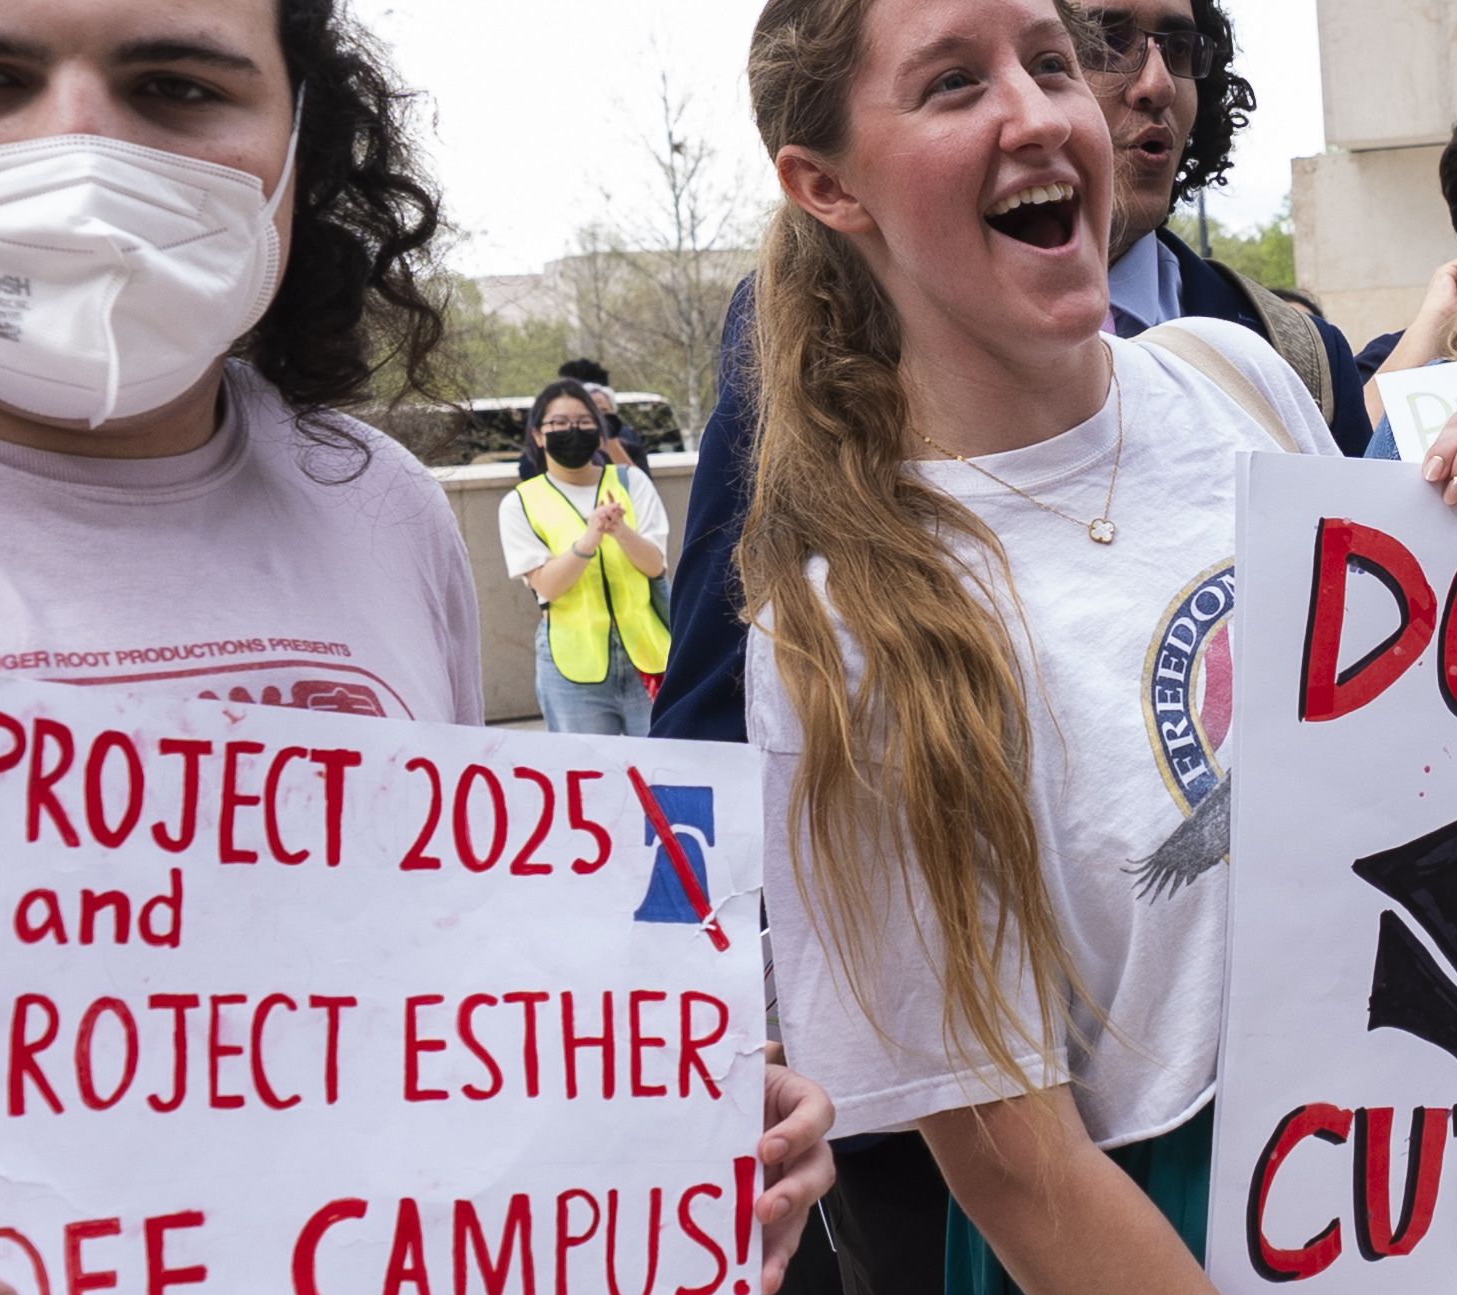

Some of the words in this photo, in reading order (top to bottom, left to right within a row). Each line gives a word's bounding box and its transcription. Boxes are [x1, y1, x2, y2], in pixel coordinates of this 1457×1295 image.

[55, 652, 110, 668] ROOT
[114, 638, 266, 665] PRODUCTIONS
[267, 638, 352, 657] PRESENTS
[399, 756, 612, 876] 2025
[14, 868, 183, 949] and
[402, 989, 730, 1103] ESTHER
